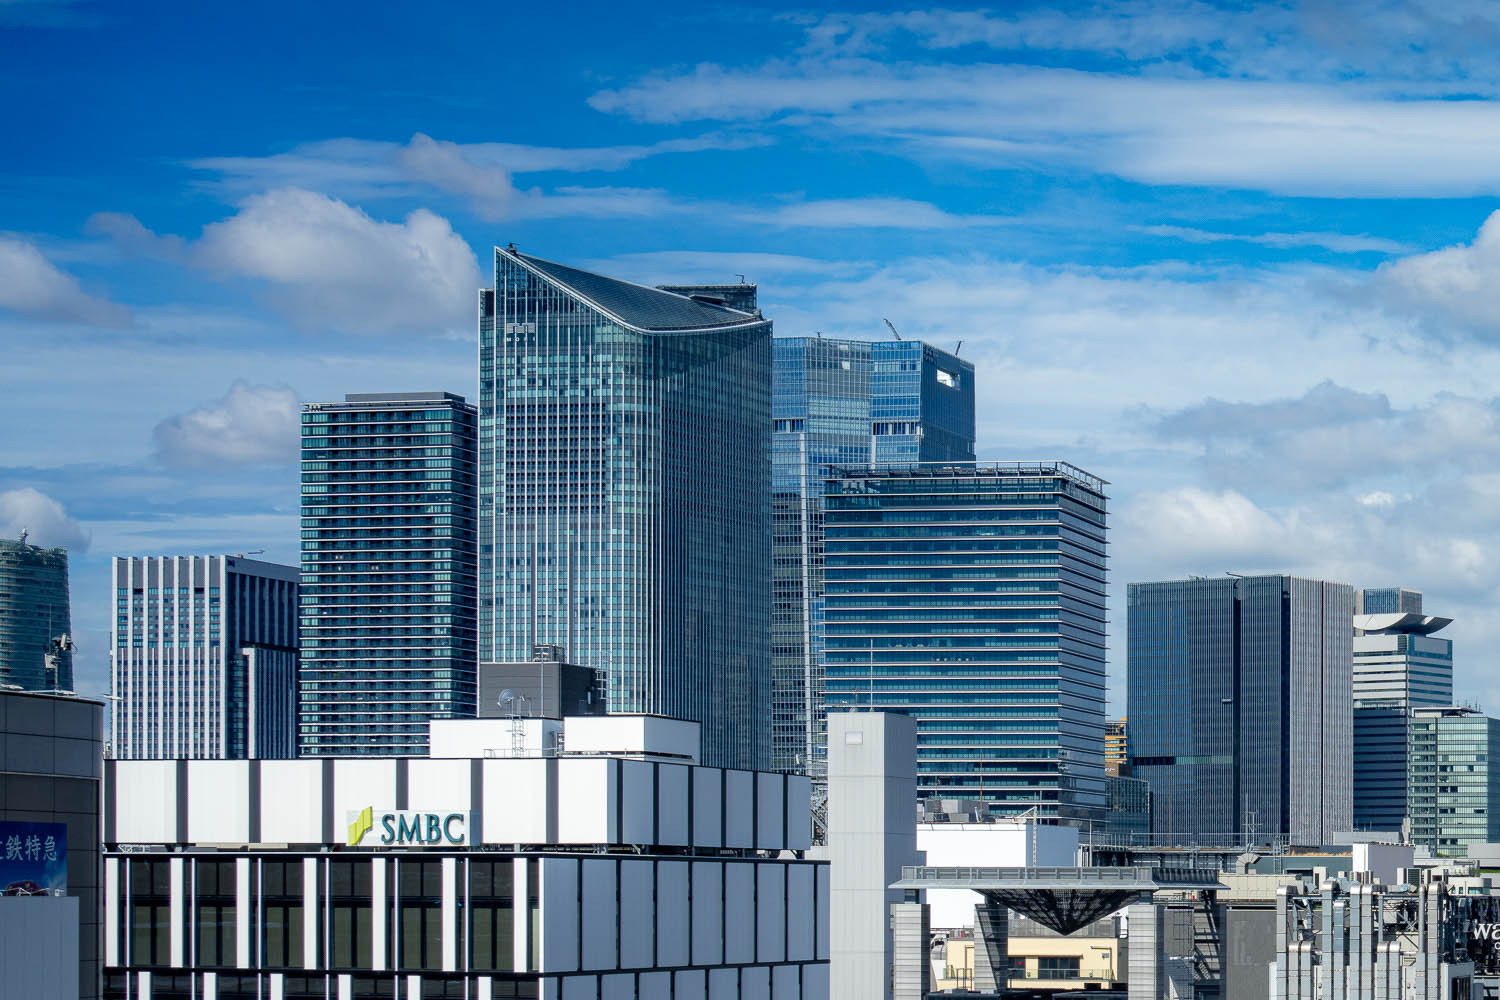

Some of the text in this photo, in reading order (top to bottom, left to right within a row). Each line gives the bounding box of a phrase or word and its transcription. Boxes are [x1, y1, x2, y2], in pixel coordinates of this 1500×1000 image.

[381, 813, 465, 844] SMBC
[0, 834, 57, 862] 鉄特急
